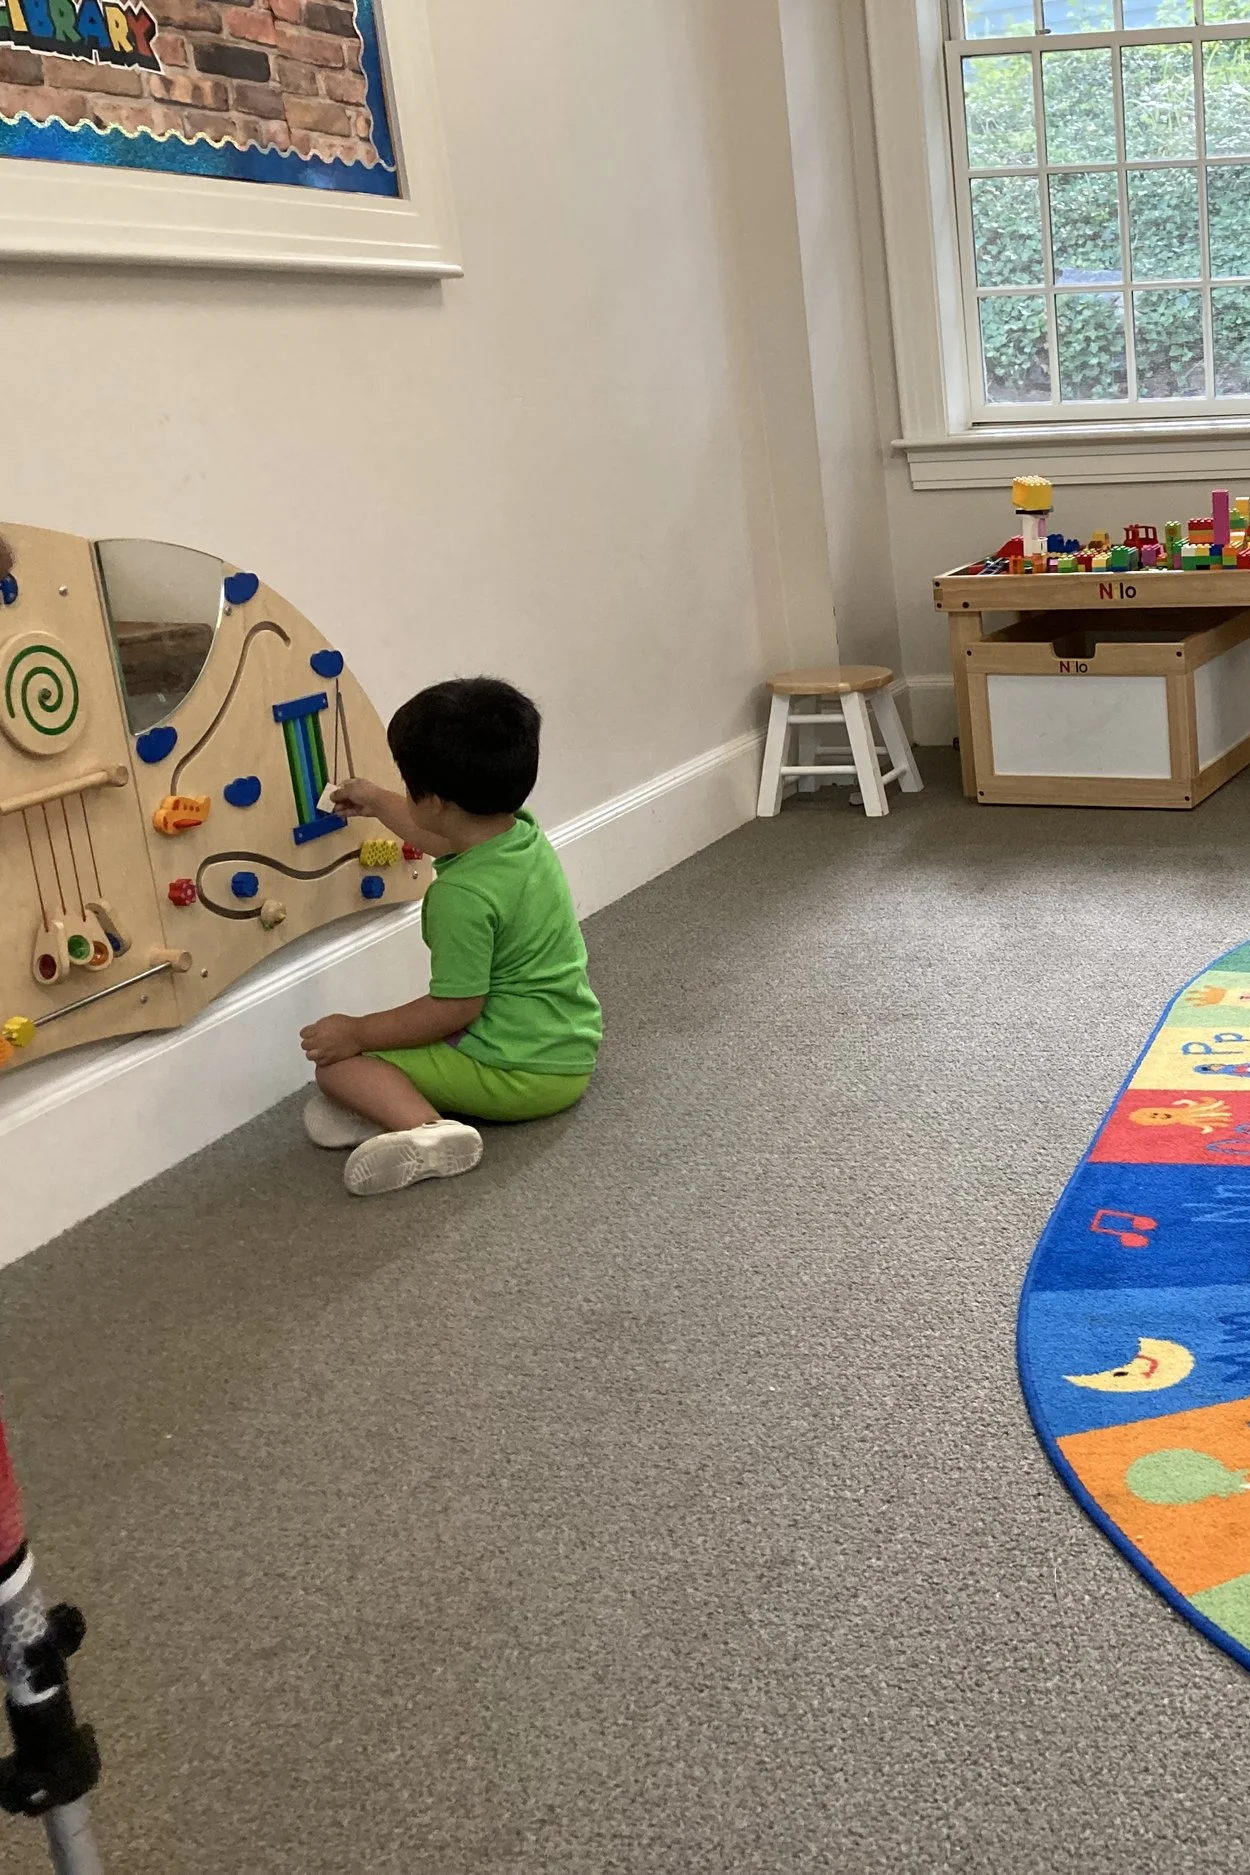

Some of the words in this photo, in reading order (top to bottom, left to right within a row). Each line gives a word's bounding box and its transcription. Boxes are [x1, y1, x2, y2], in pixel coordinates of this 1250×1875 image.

[0, 0, 154, 56] IBRARY
[1099, 582, 1137, 600] Nlo
[1060, 660, 1088, 673] Nlo
